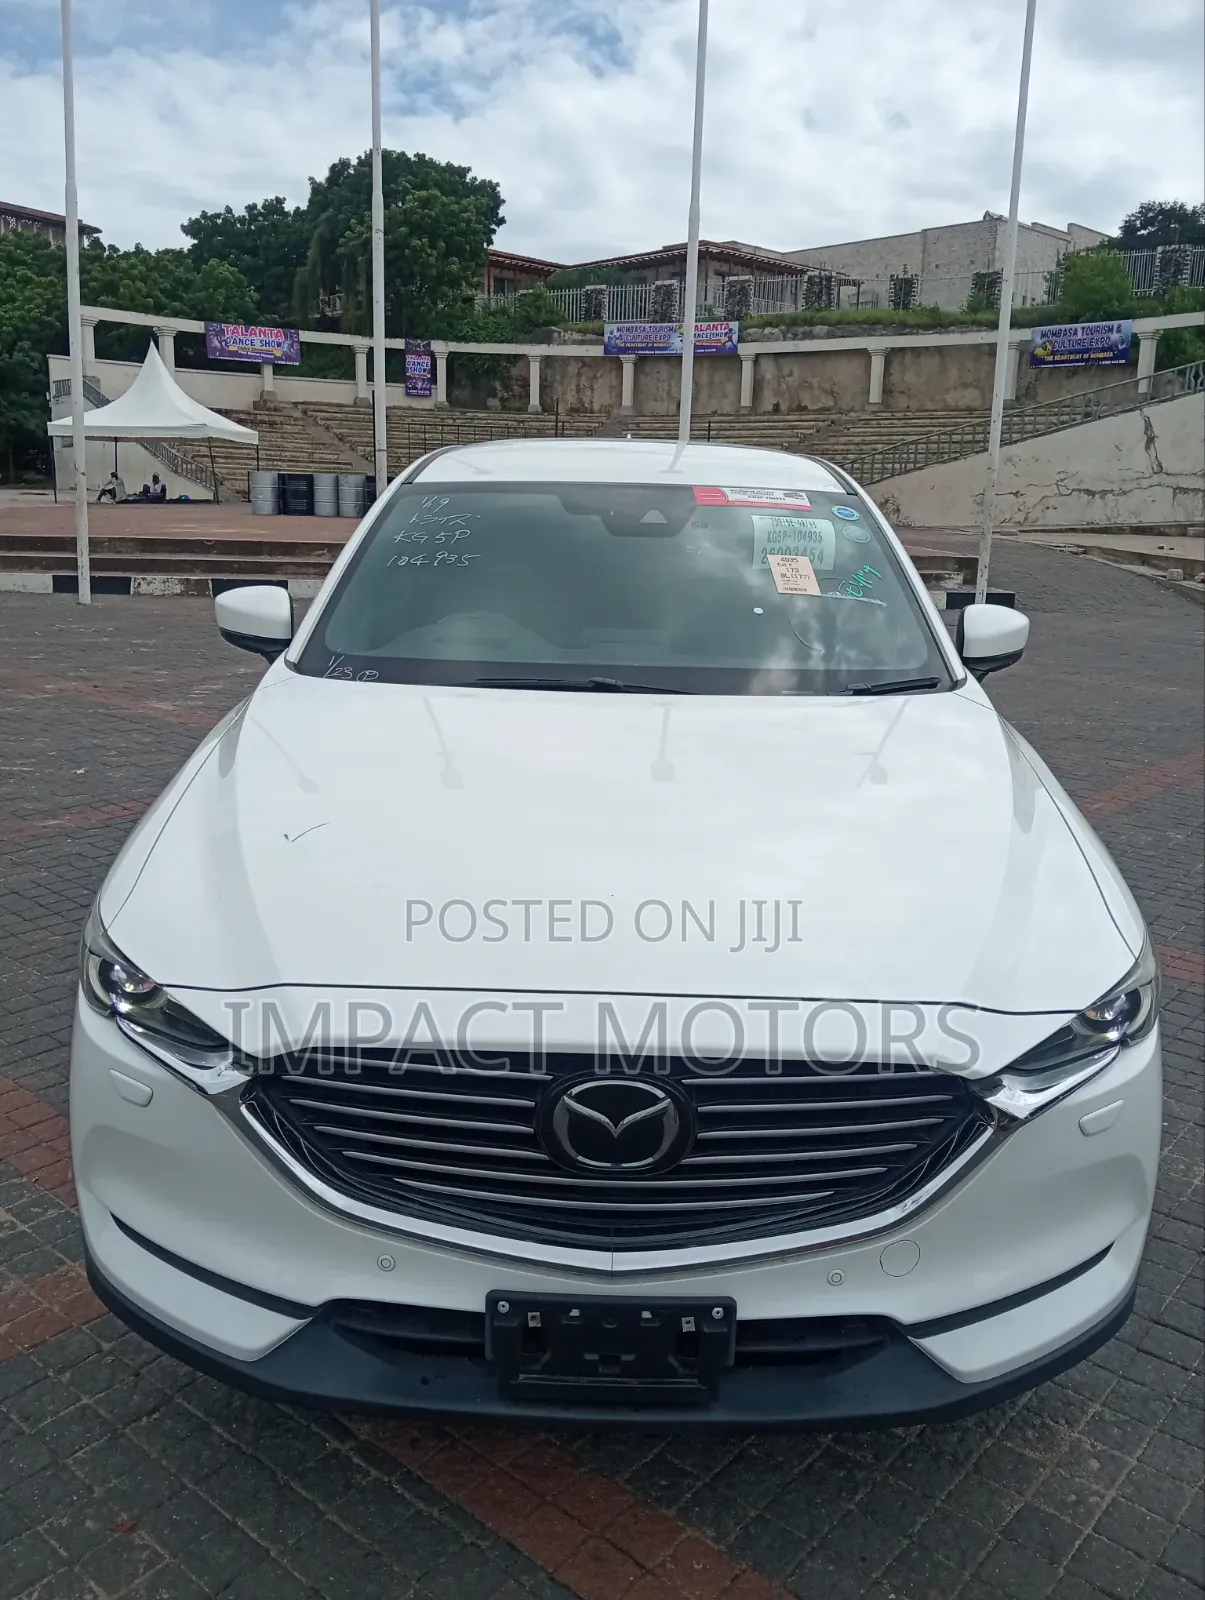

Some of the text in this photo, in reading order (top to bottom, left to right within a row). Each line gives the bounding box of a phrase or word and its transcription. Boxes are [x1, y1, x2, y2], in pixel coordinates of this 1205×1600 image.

[222, 324, 284, 340] TALANTA
[616, 325, 646, 333] MOMBASA
[694, 323, 730, 332] ALANTA
[1040, 324, 1122, 340] MOMBASA TOURISM &
[225, 337, 283, 348] DANCE SHOW
[1053, 336, 1111, 350] CULTURE EXPO
[767, 530, 823, 544] KG5P-104935
